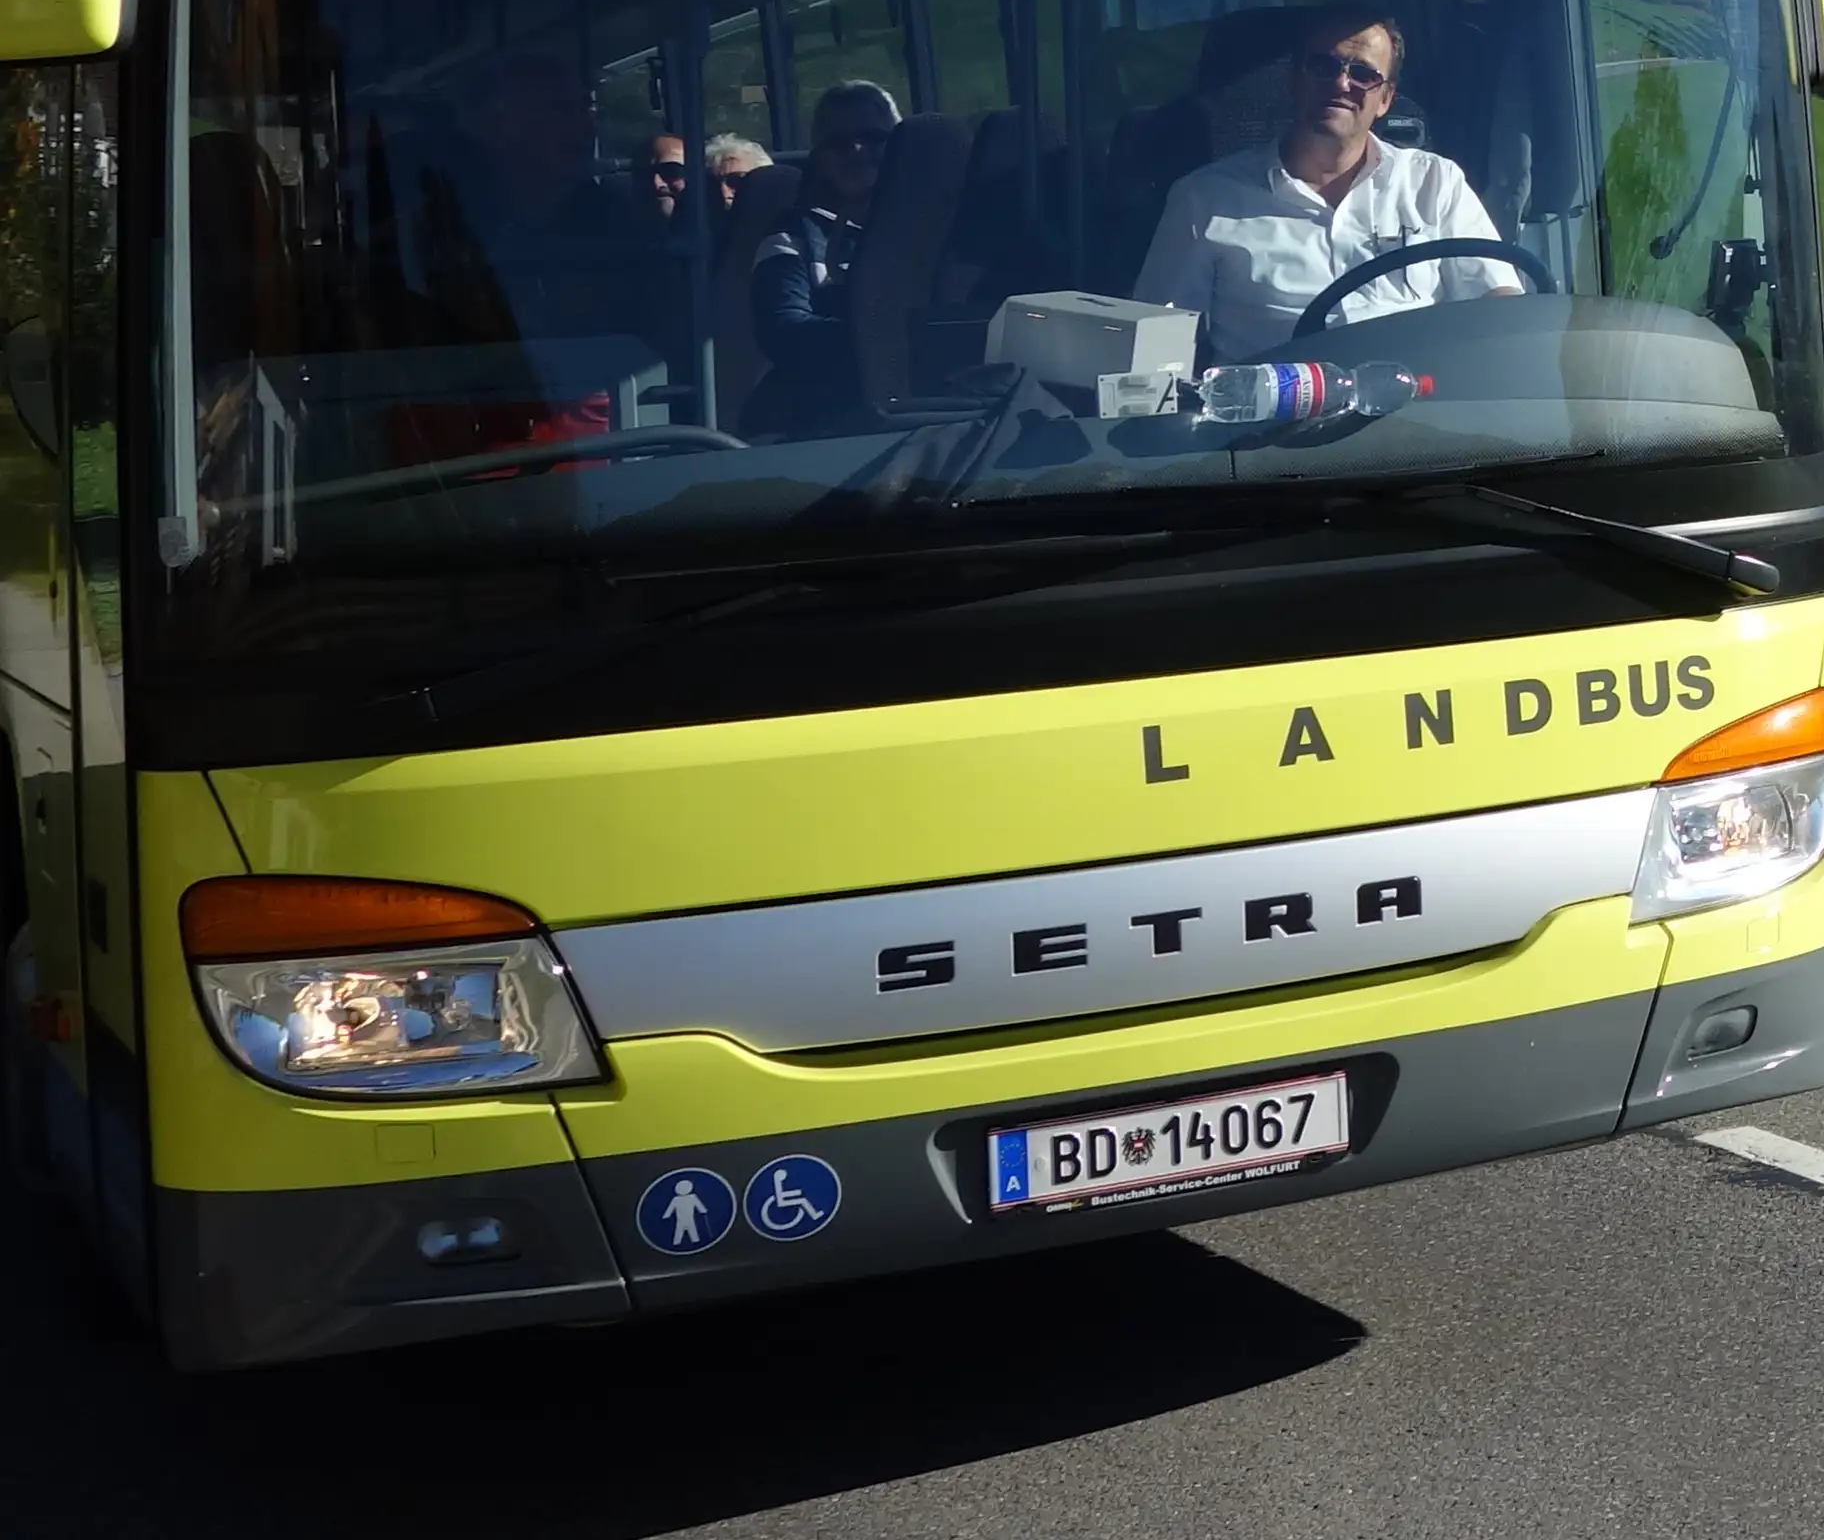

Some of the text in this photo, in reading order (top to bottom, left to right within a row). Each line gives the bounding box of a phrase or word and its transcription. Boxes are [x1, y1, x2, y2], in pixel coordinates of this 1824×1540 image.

[1142, 655, 1715, 784] LANDBUS
[876, 875, 1423, 994] SETRA
[1005, 1175, 1021, 1192] A
[1051, 1092, 1318, 1186] BD 14067
[1091, 1172, 1243, 1206] Bustechnik-Service-Center
[1244, 1160, 1301, 1179] WOLFURT
